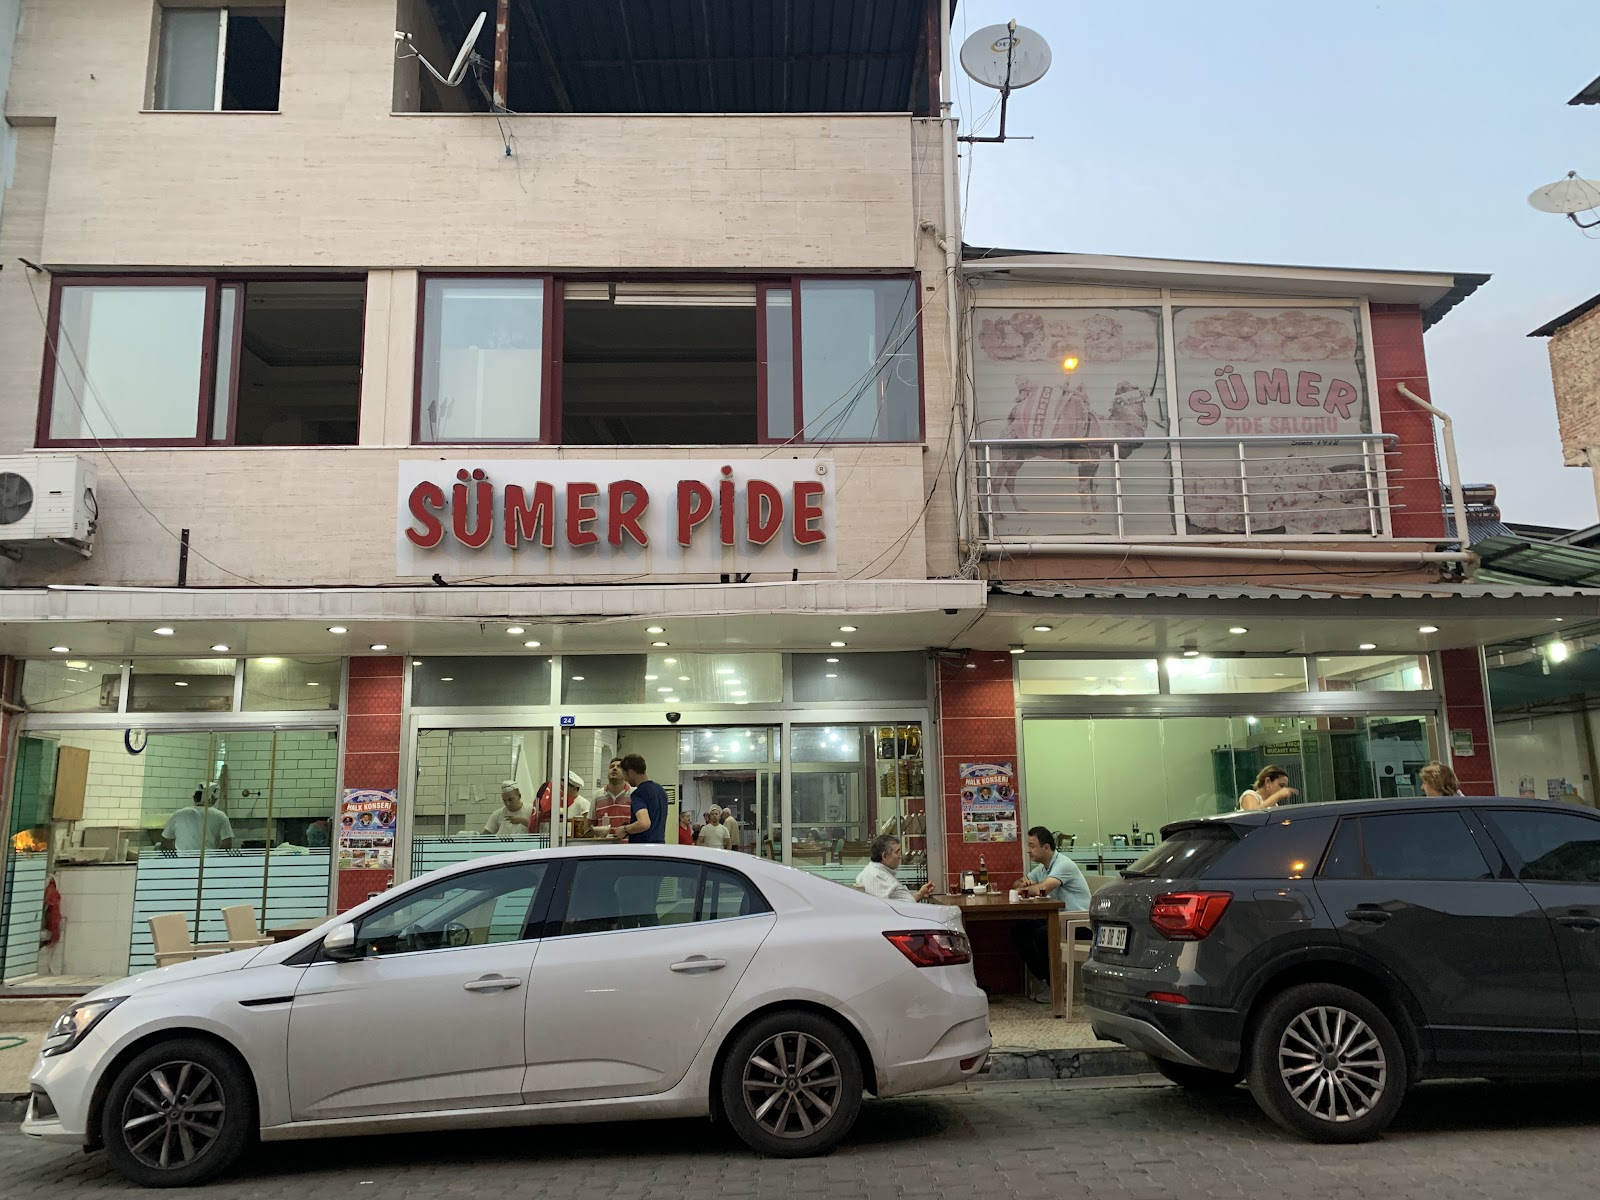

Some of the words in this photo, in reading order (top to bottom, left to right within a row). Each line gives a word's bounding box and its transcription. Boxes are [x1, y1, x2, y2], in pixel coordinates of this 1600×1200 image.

[1188, 364, 1358, 426] SÜMER
[1269, 416, 1338, 434] SALONU
[404, 467, 650, 549] SÜMER
[677, 464, 826, 547] PİDE
[965, 778, 981, 786] HALK
[346, 803, 363, 811] HALK
